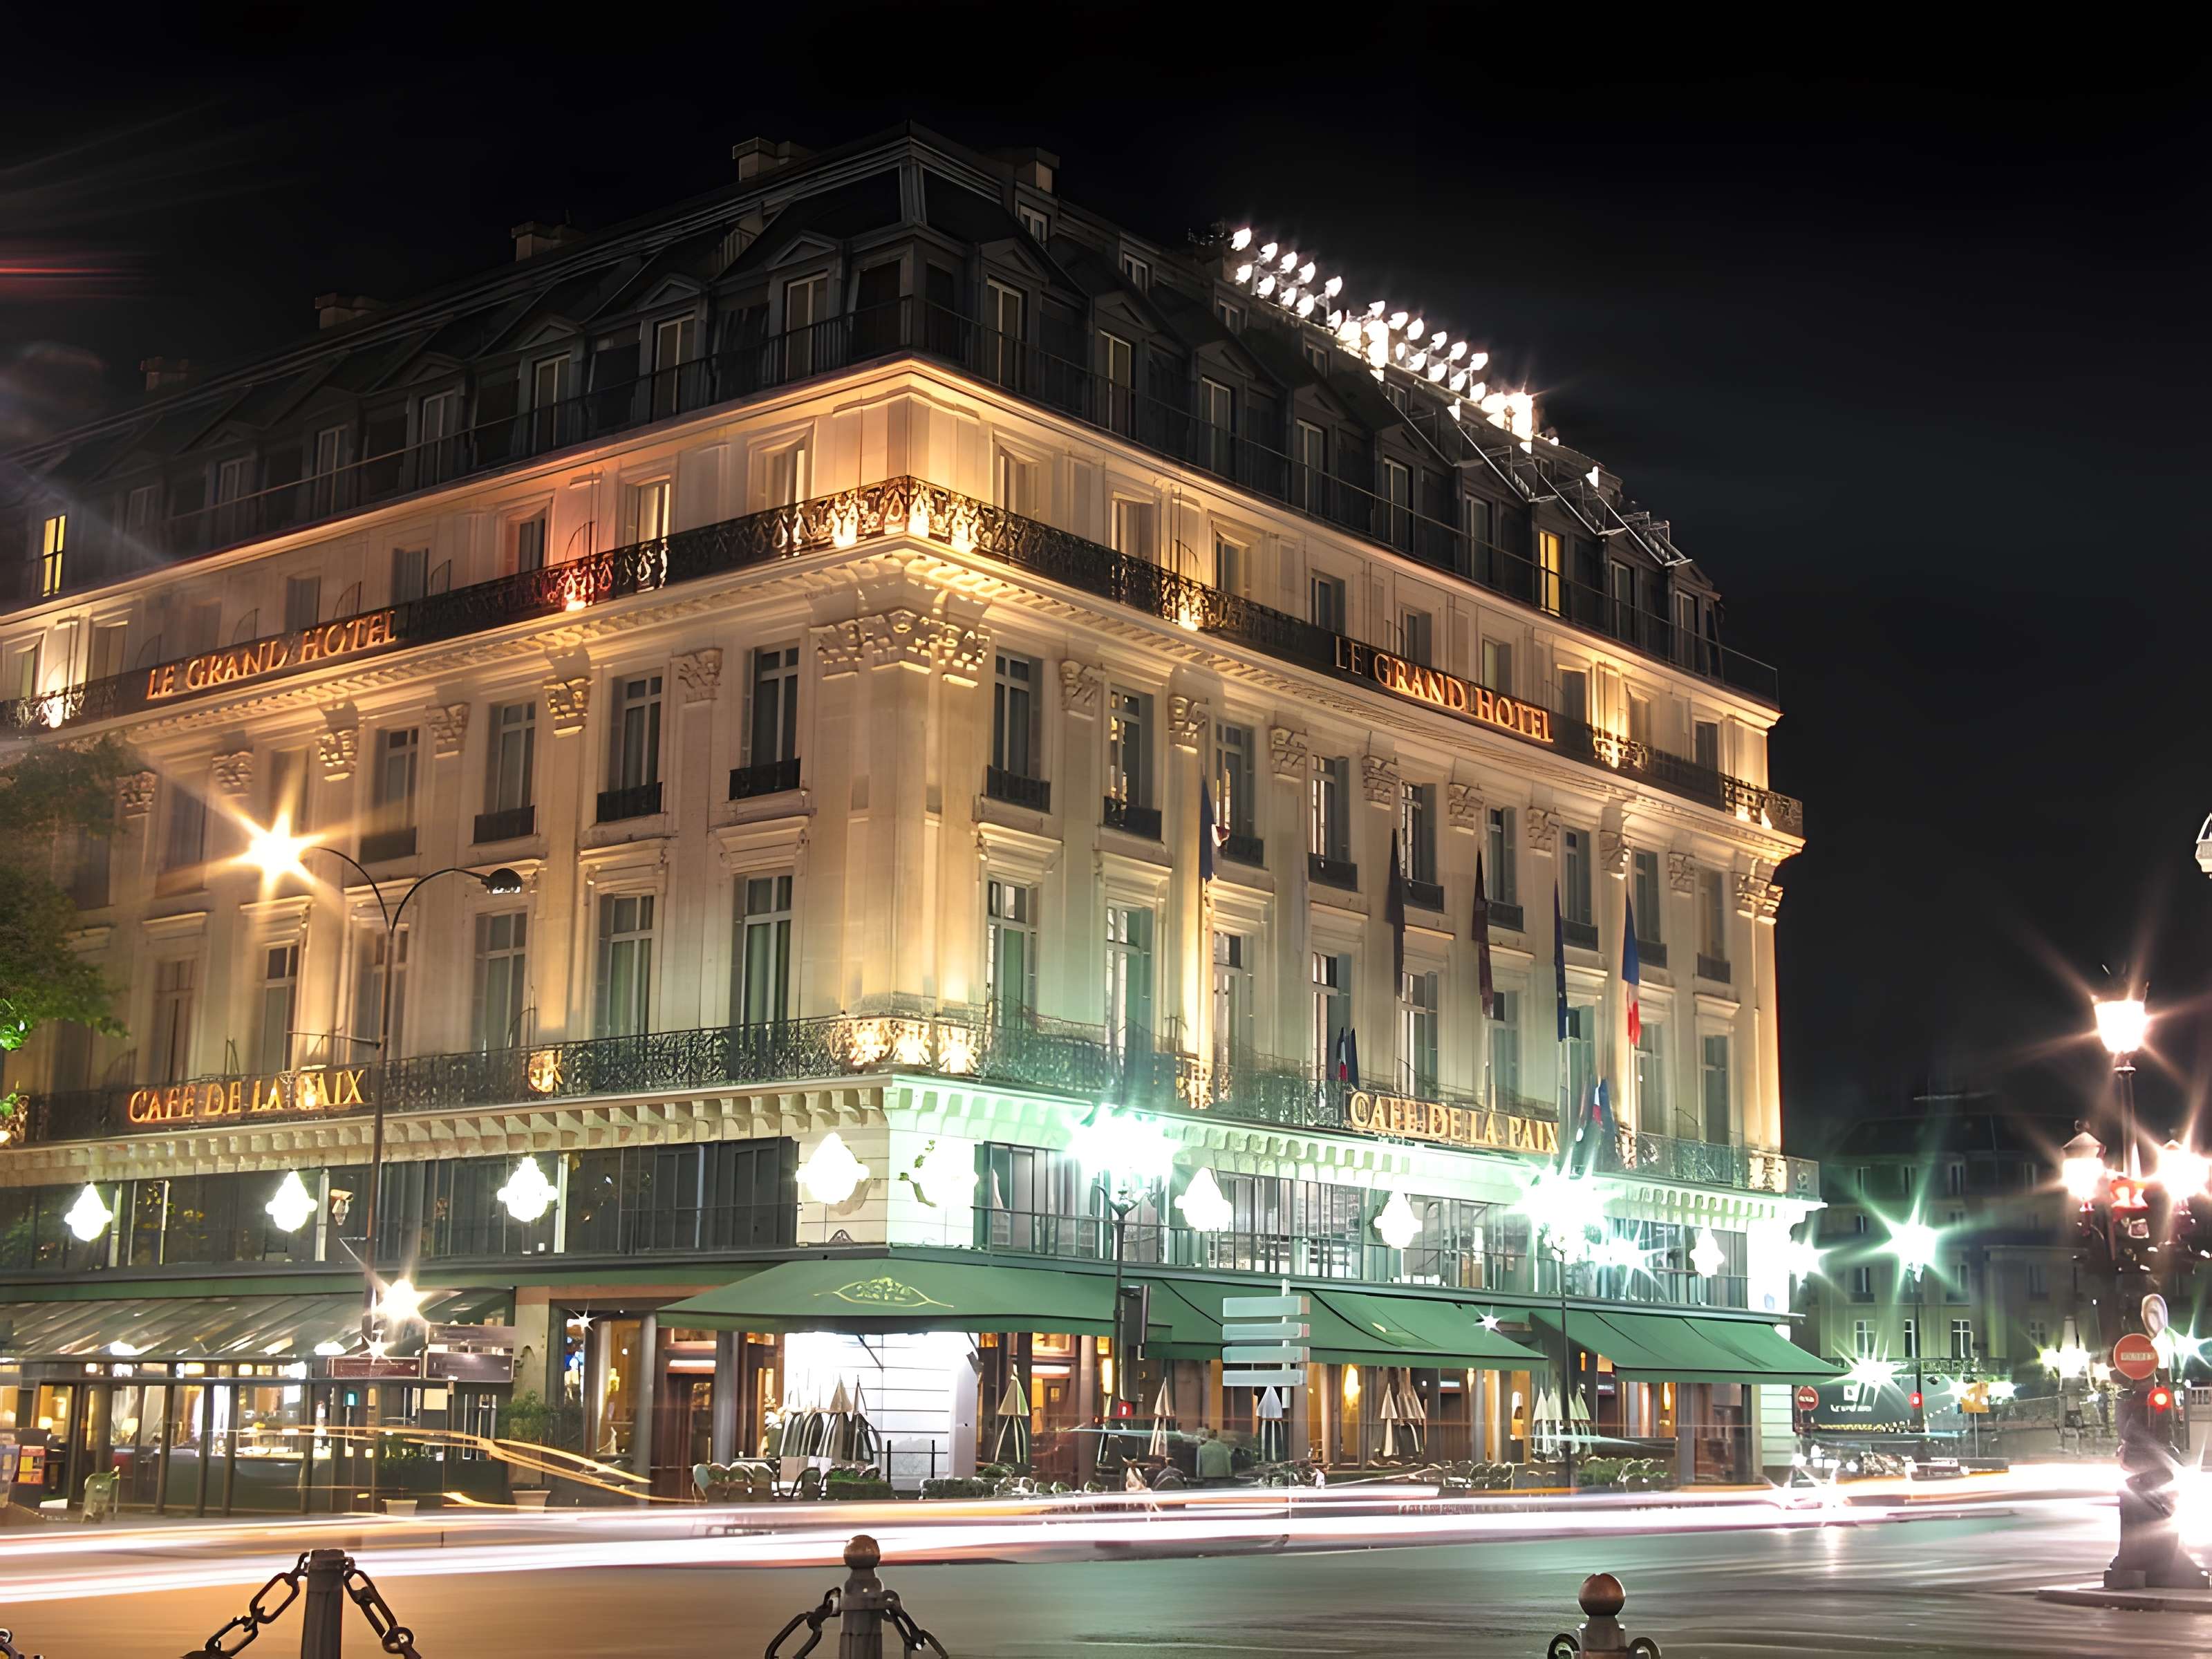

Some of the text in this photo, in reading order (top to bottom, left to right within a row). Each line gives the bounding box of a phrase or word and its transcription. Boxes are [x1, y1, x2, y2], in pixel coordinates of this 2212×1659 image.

[146, 610, 397, 700] LE GRAND HOTEL
[1335, 635, 1554, 742] LE GRAND HOTEL
[204, 1080, 241, 1116] DE
[250, 1079, 283, 1112] LA
[1429, 1103, 1464, 1141] DE
[1468, 1109, 1499, 1145] LA
